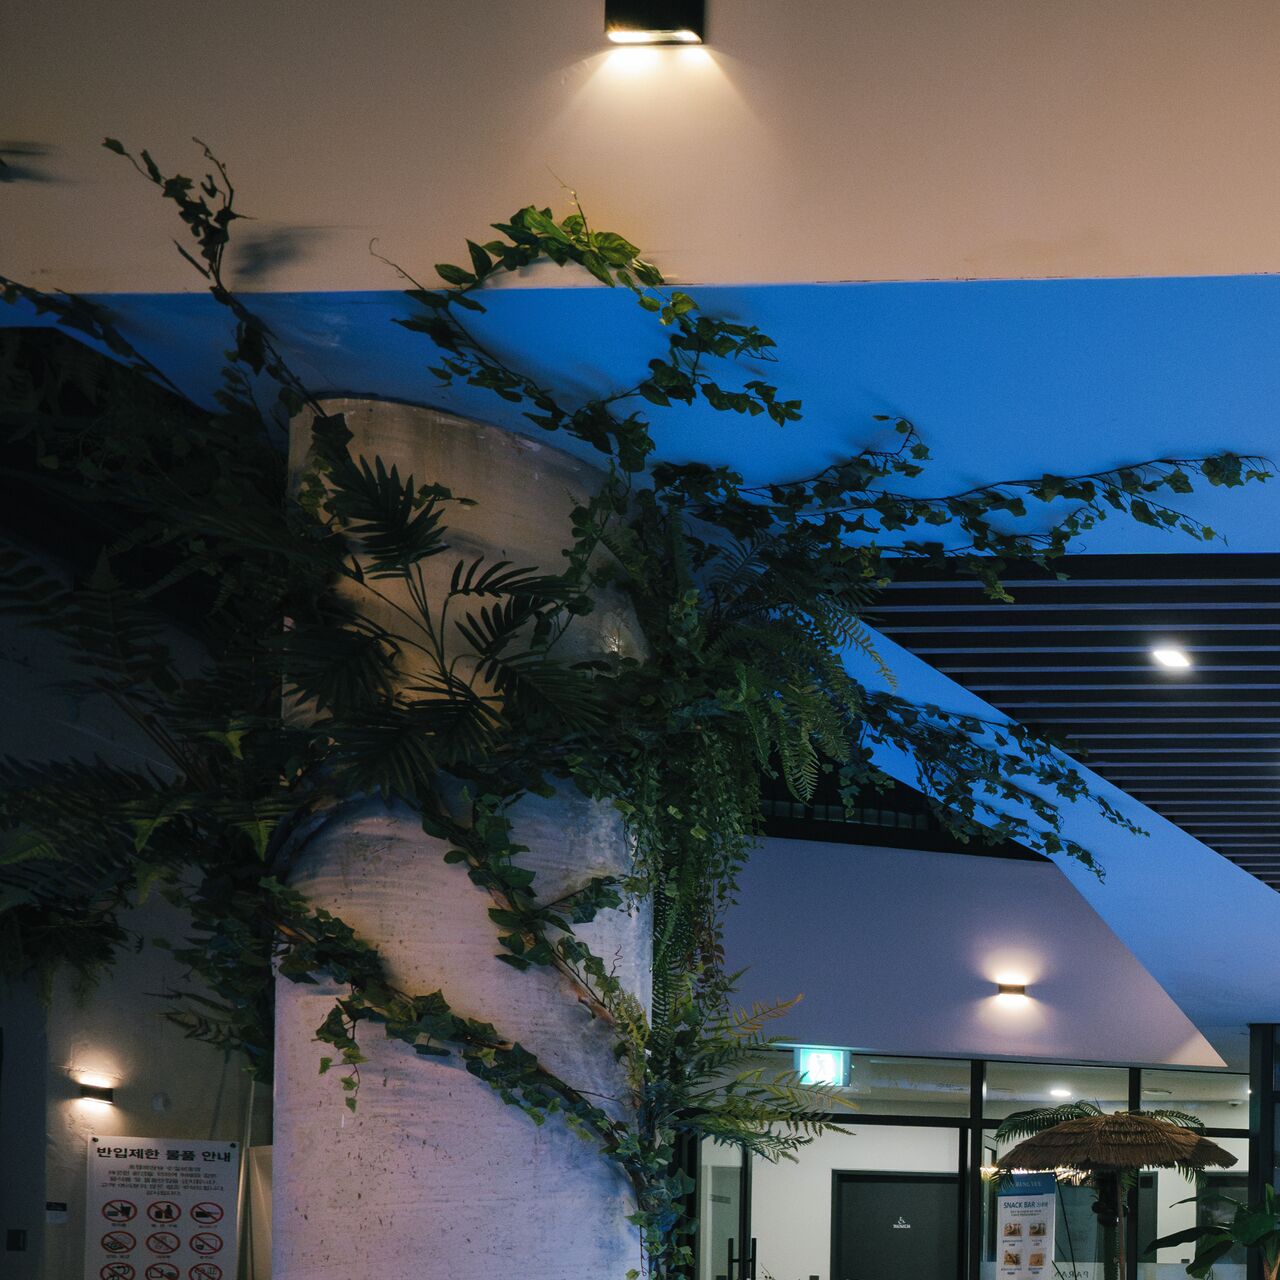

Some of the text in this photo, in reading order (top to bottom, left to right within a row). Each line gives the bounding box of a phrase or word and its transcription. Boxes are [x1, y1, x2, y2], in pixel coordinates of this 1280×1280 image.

[97, 1147, 231, 1163] 반입제한 물품 안내
[1003, 1201, 1022, 1209] SNACK
